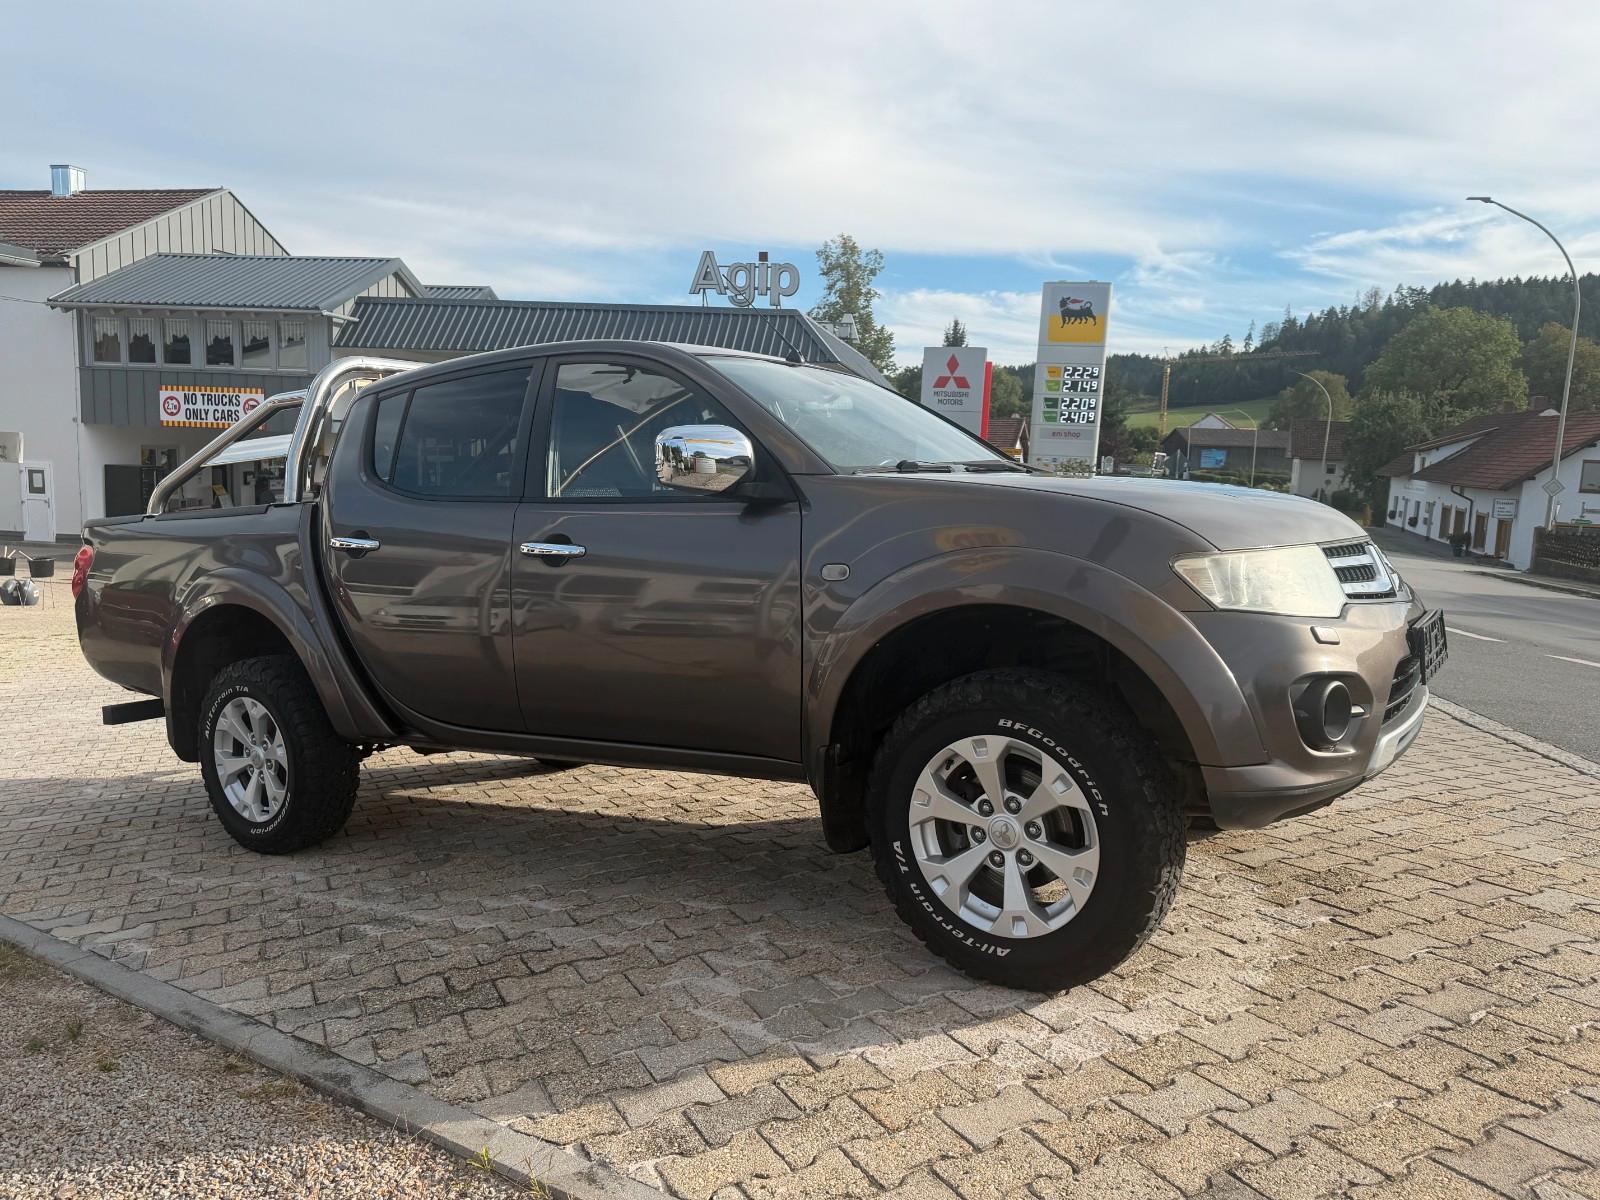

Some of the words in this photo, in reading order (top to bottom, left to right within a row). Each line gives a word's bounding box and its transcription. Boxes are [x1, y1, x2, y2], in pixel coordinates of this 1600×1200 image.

[689, 251, 800, 307] Agip
[1064, 366, 1100, 379] 2.229
[1062, 380, 1098, 393] 2.149
[183, 392, 198, 406] NO
[201, 393, 241, 407] TRUCKS
[933, 390, 970, 398] MITSUBISHI
[937, 398, 964, 406] MOTORS
[1061, 398, 1096, 410] 2.209
[184, 407, 210, 421] ONLY
[213, 409, 240, 422] CARS
[1060, 411, 1095, 423] 2.409
[1064, 430, 1081, 438] shop
[204, 687, 234, 740] All-Terrain
[236, 685, 250, 693] T/A
[997, 718, 1109, 817] BFGoodrich
[909, 882, 1011, 957] All-Terrain
